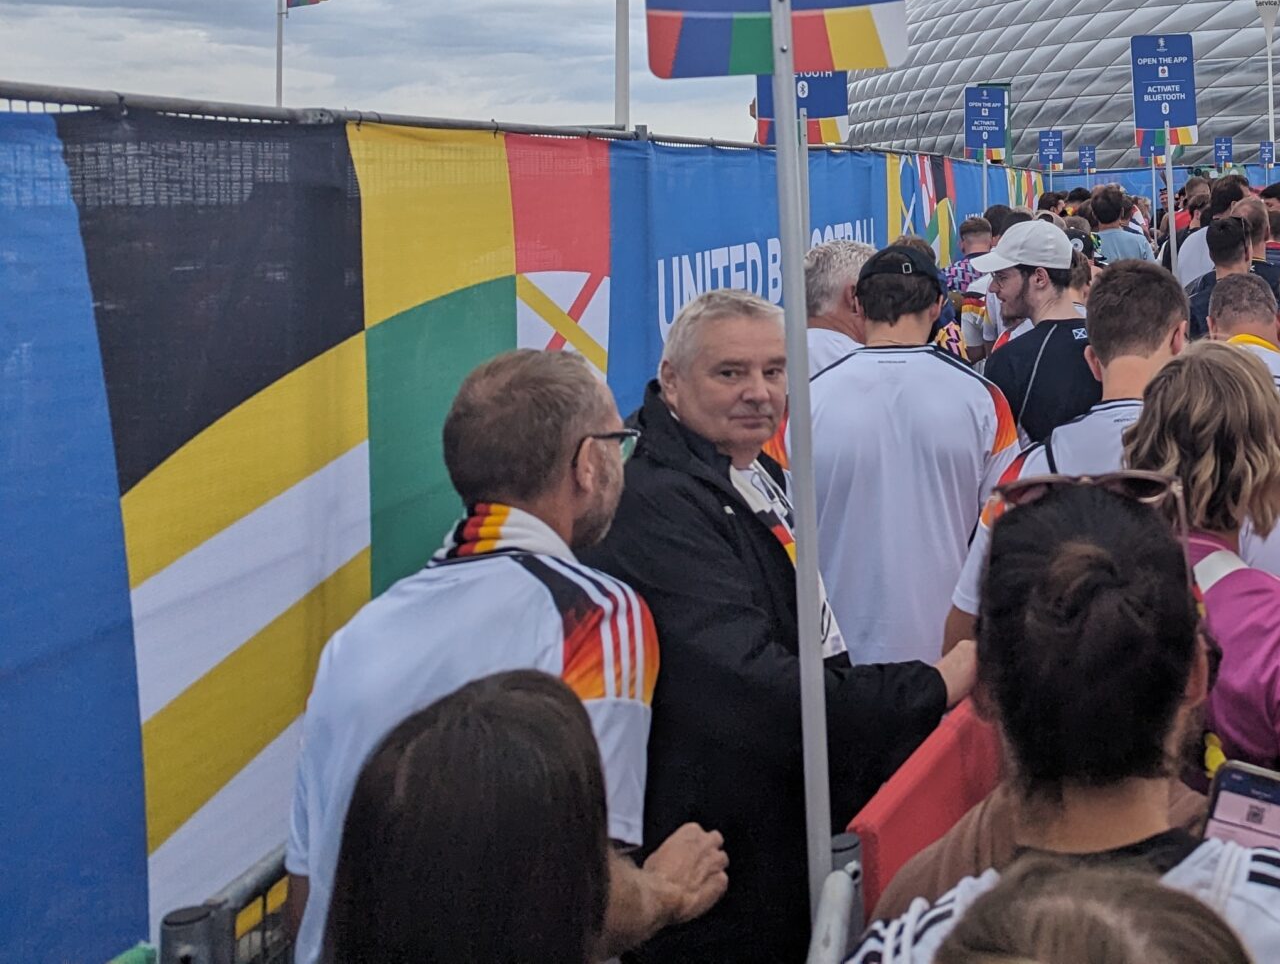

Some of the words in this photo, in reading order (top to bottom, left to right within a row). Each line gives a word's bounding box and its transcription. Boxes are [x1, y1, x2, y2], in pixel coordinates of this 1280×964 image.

[1173, 56, 1188, 64] APP
[1147, 85, 1180, 93] ACTIVATE
[1144, 93, 1185, 102] BLUETOOTH
[657, 241, 763, 346] UNITED
[767, 238, 783, 304] B
